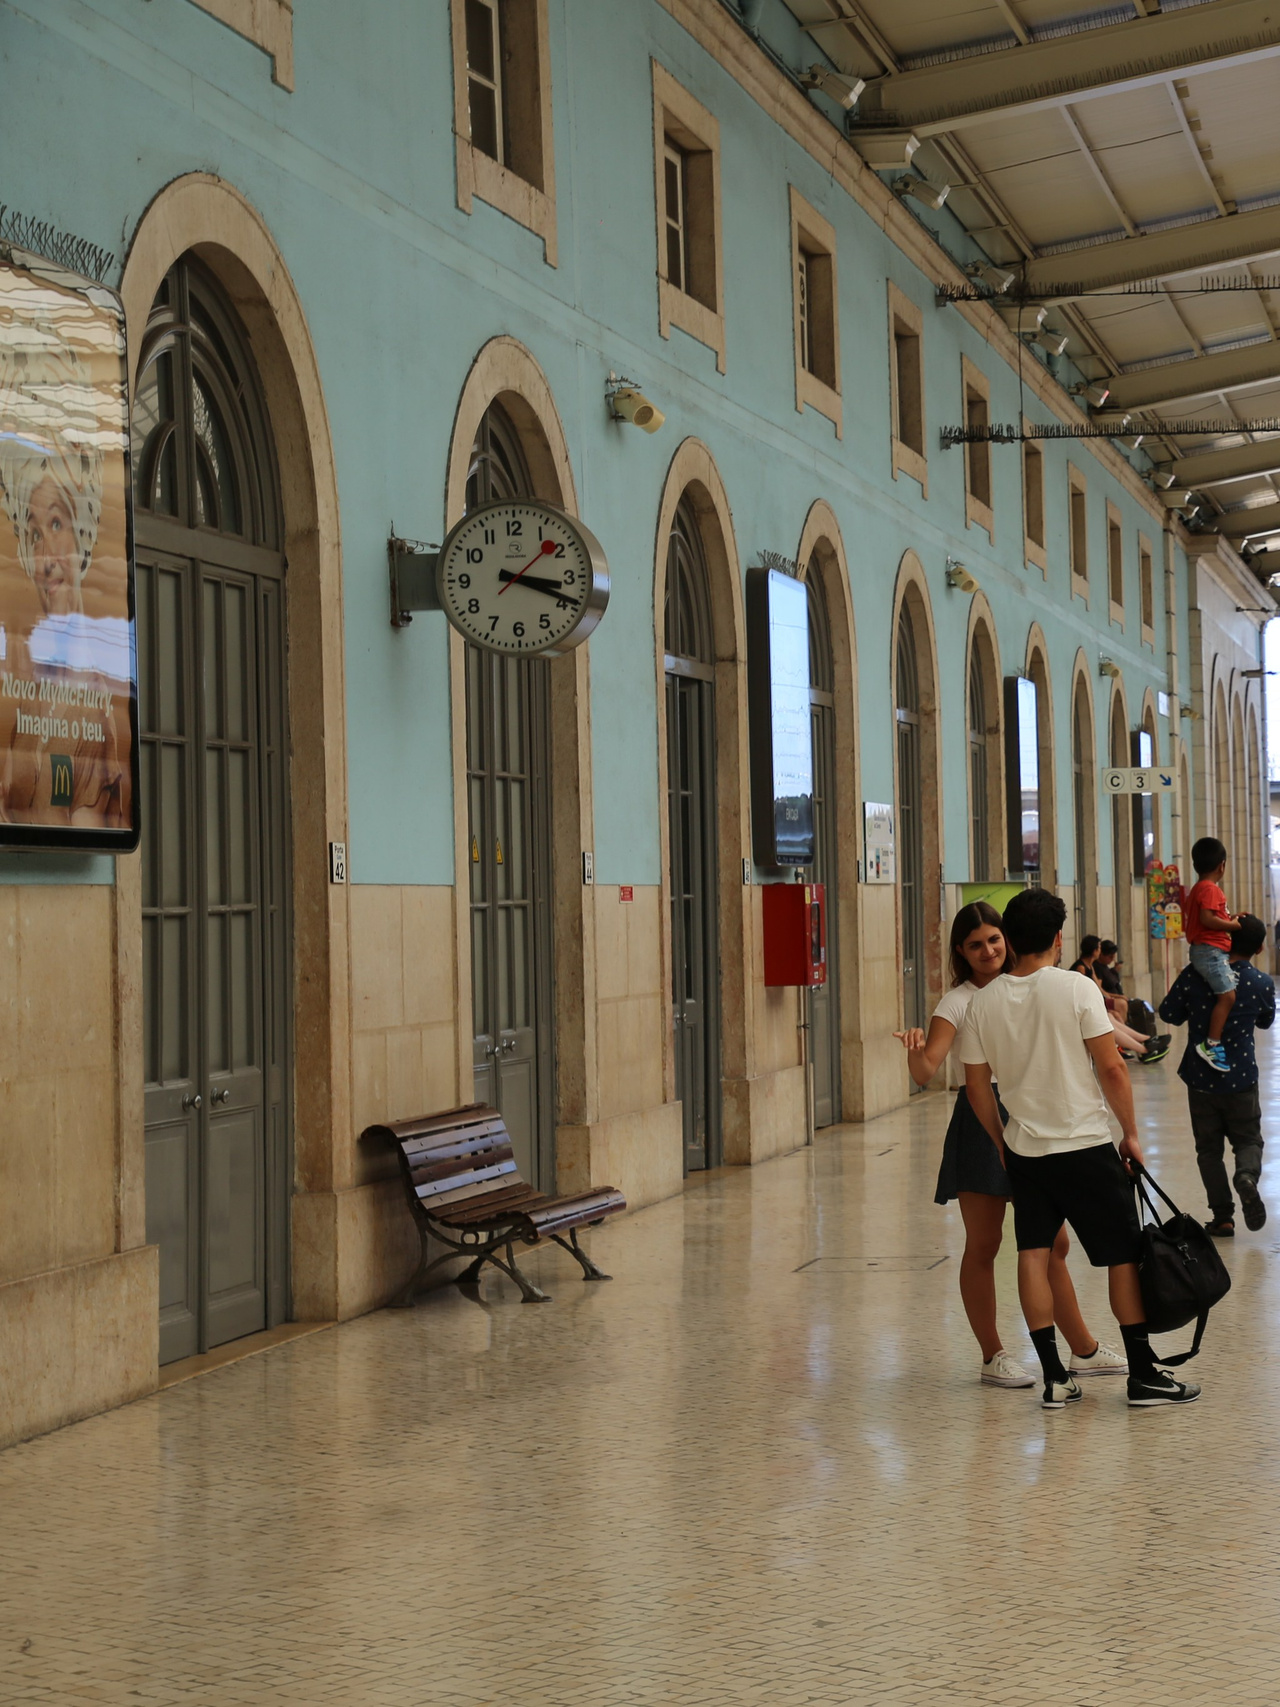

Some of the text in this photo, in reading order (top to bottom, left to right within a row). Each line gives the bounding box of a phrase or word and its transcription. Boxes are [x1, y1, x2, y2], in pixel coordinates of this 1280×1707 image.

[506, 520, 523, 536] 12
[538, 526, 543, 542] 1
[484, 529, 495, 545] 11
[466, 548, 483, 564] 10
[554, 543, 566, 559] 2
[458, 573, 471, 589] 9
[563, 569, 575, 586] 3
[467, 598, 480, 614] 8
[555, 597, 569, 611] 4
[488, 616, 500, 631] 7
[512, 621, 525, 638] 6
[539, 614, 551, 630] 5
[2, 672, 114, 718] Novo MyMcFlurry.
[16, 708, 105, 743] Imagina o teu.
[1110, 775, 1145, 789] C 3
[335, 862, 344, 880] 42
